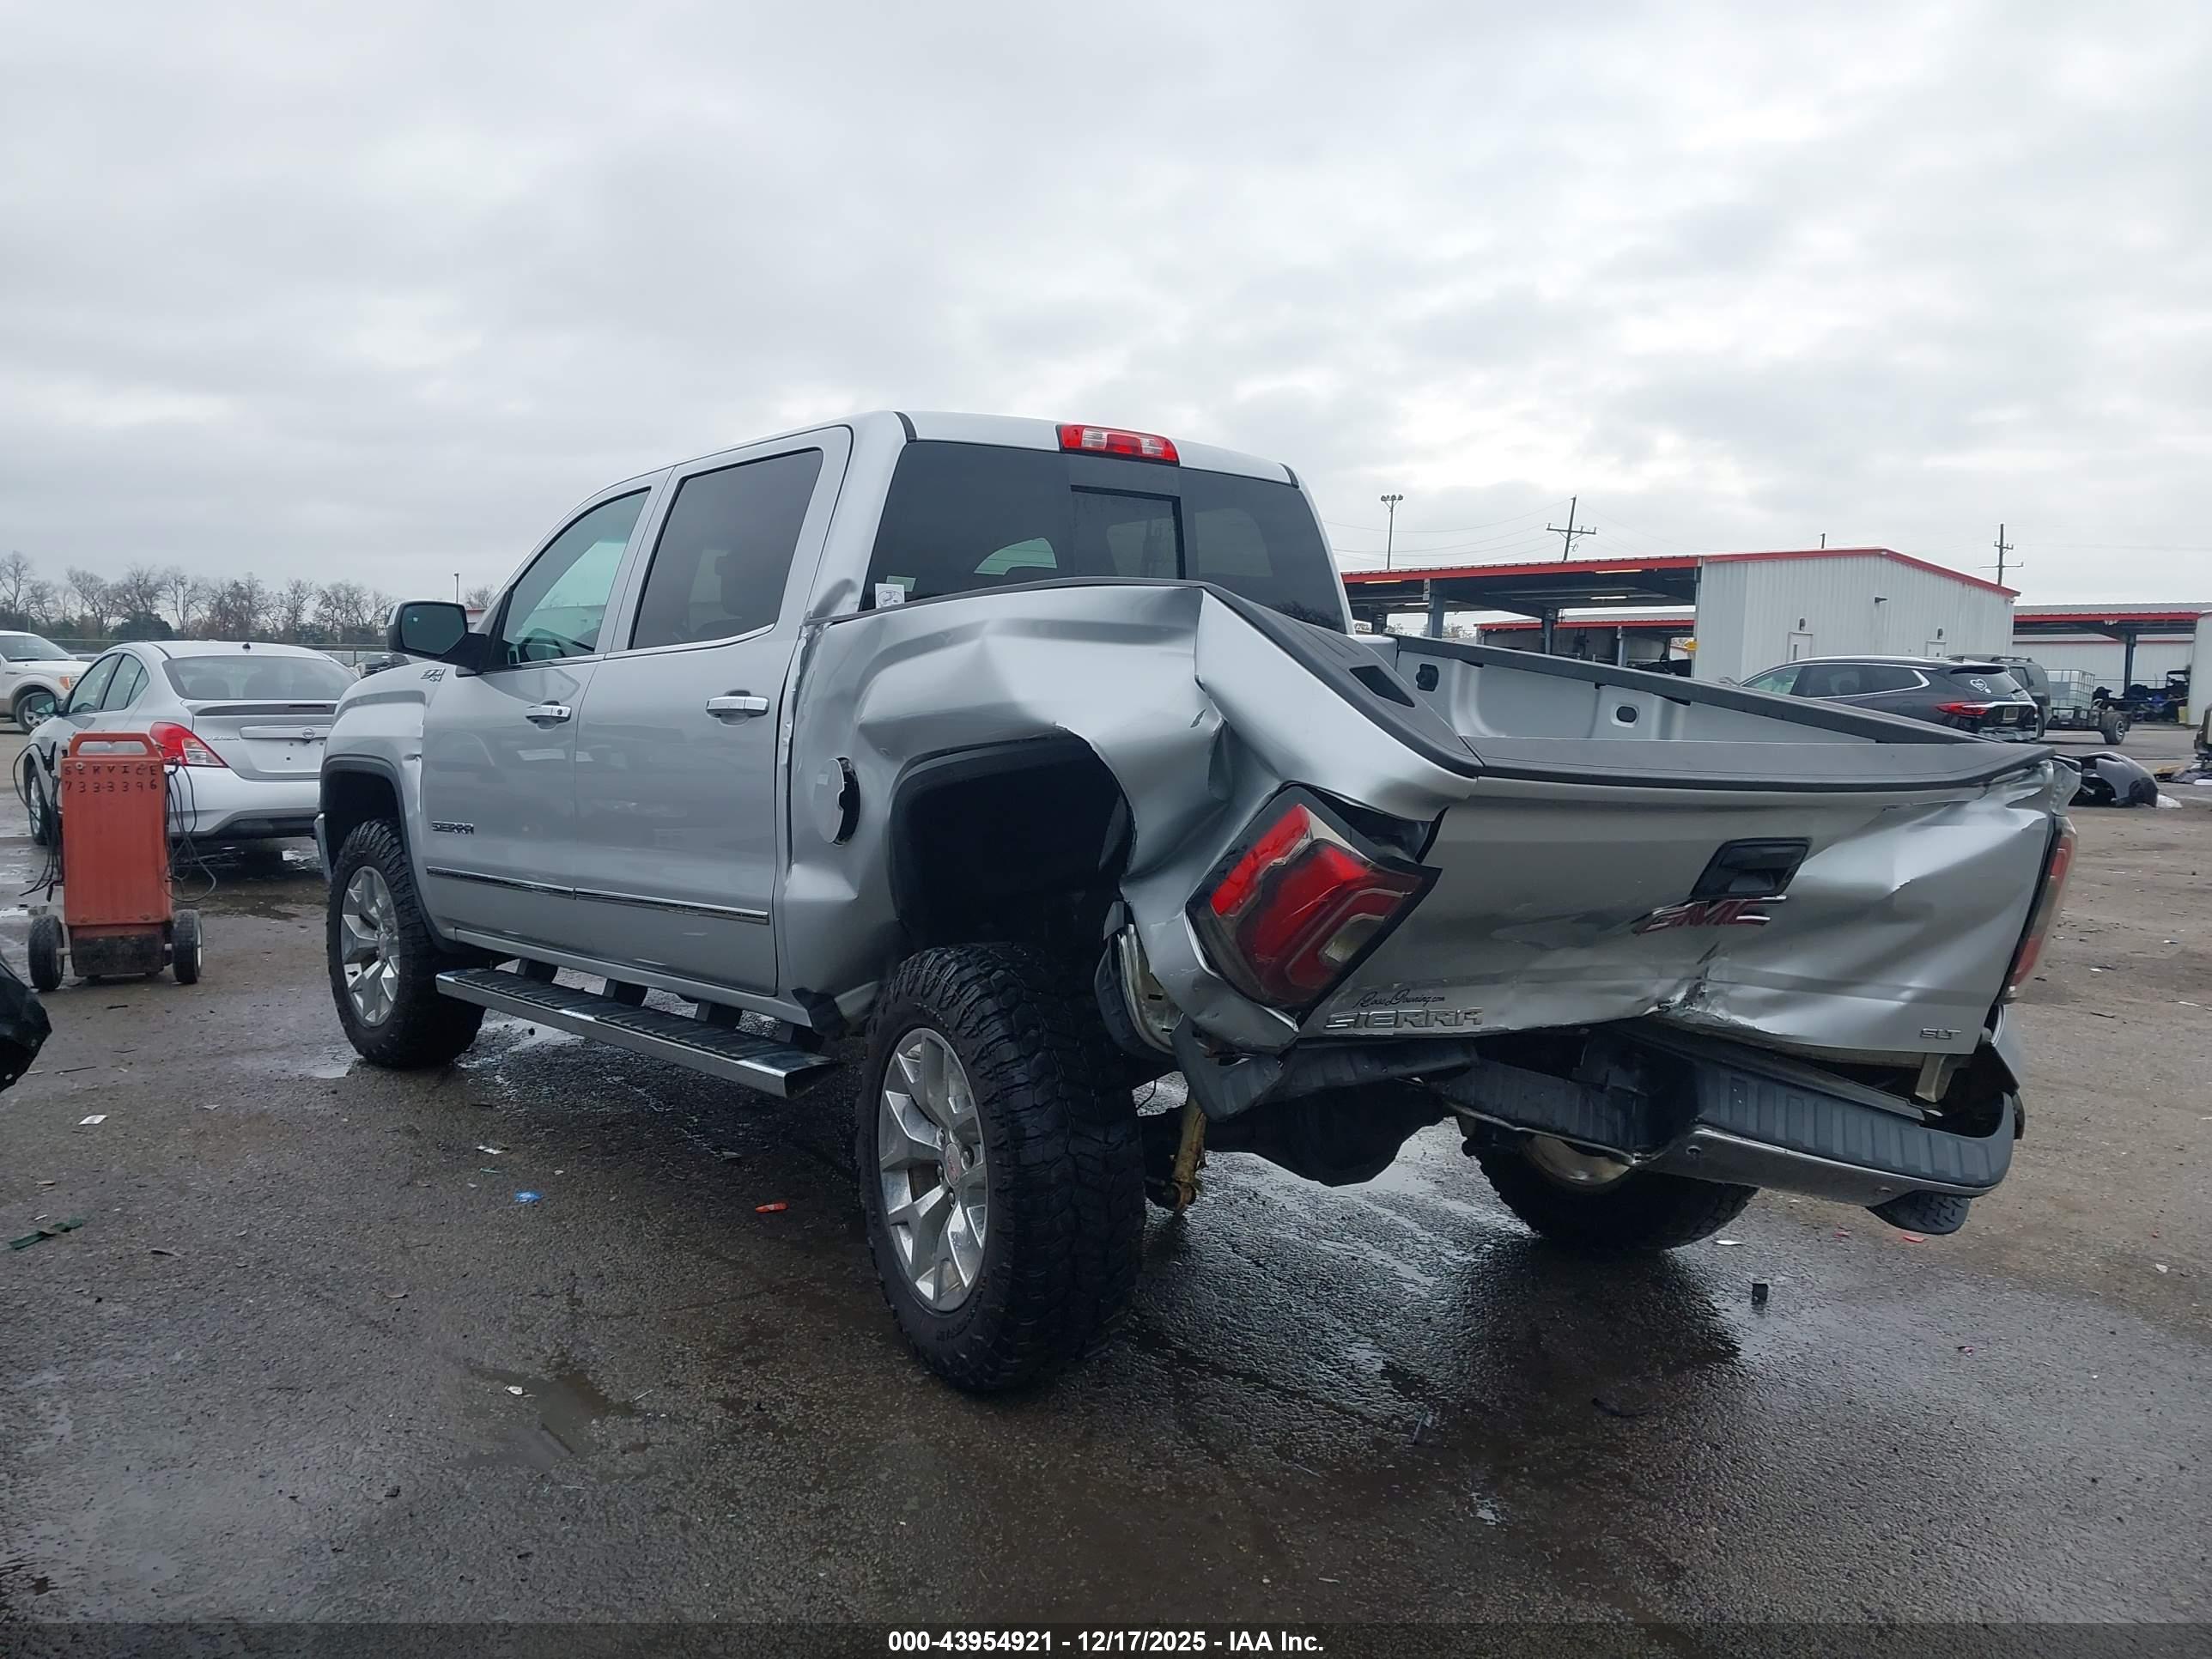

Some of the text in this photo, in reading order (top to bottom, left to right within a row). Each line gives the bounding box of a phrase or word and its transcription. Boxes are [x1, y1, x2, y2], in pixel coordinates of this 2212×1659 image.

[432, 820, 475, 835] SIERRA
[1632, 895, 1787, 936] GMC
[1324, 1007, 1485, 1029] SIERRA
[1920, 1028, 1962, 1040] SLT
